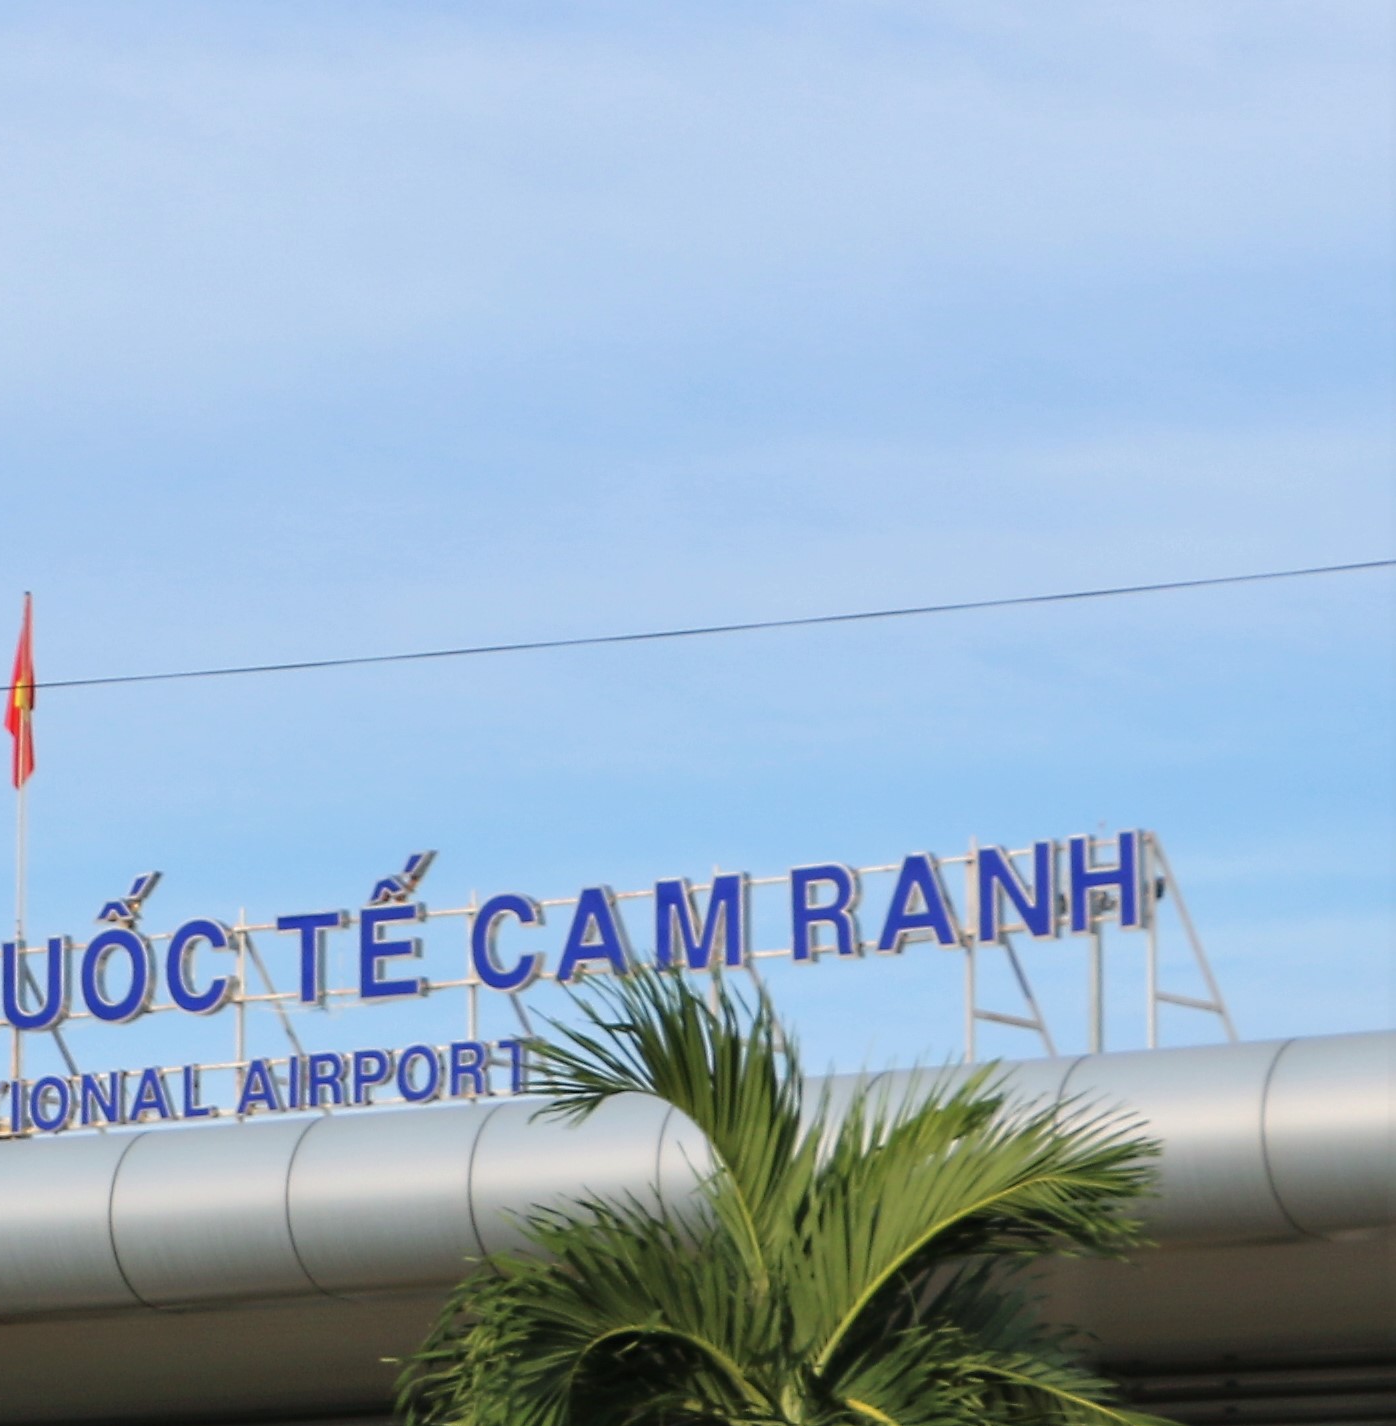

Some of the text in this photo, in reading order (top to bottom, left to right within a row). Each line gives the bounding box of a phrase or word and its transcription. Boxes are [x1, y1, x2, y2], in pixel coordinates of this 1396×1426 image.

[275, 850, 437, 999] TẾ
[471, 870, 753, 993] CAM
[790, 829, 1150, 963] RANH
[236, 1039, 530, 1114] AIRPORT
